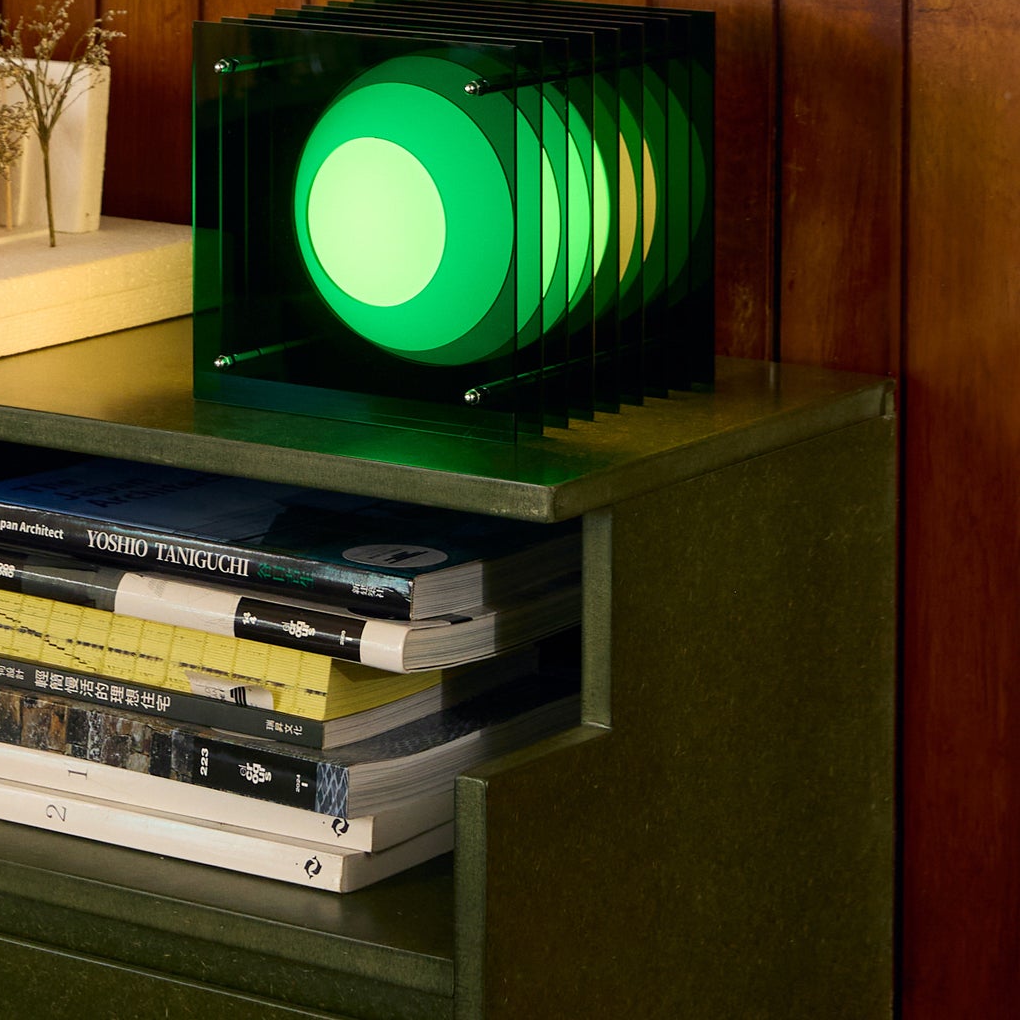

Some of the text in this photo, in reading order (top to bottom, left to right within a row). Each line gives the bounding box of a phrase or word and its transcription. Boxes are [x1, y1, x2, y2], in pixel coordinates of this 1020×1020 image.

[19, 520, 65, 541] Architect
[87, 530, 148, 557] YOSHIO
[154, 542, 251, 577] TANIGUCHI
[34, 669, 171, 712] 輕簡慢活的理想住宅
[68, 768, 88, 780] 1
[200, 747, 209, 776] 223
[46, 804, 67, 822] 2
